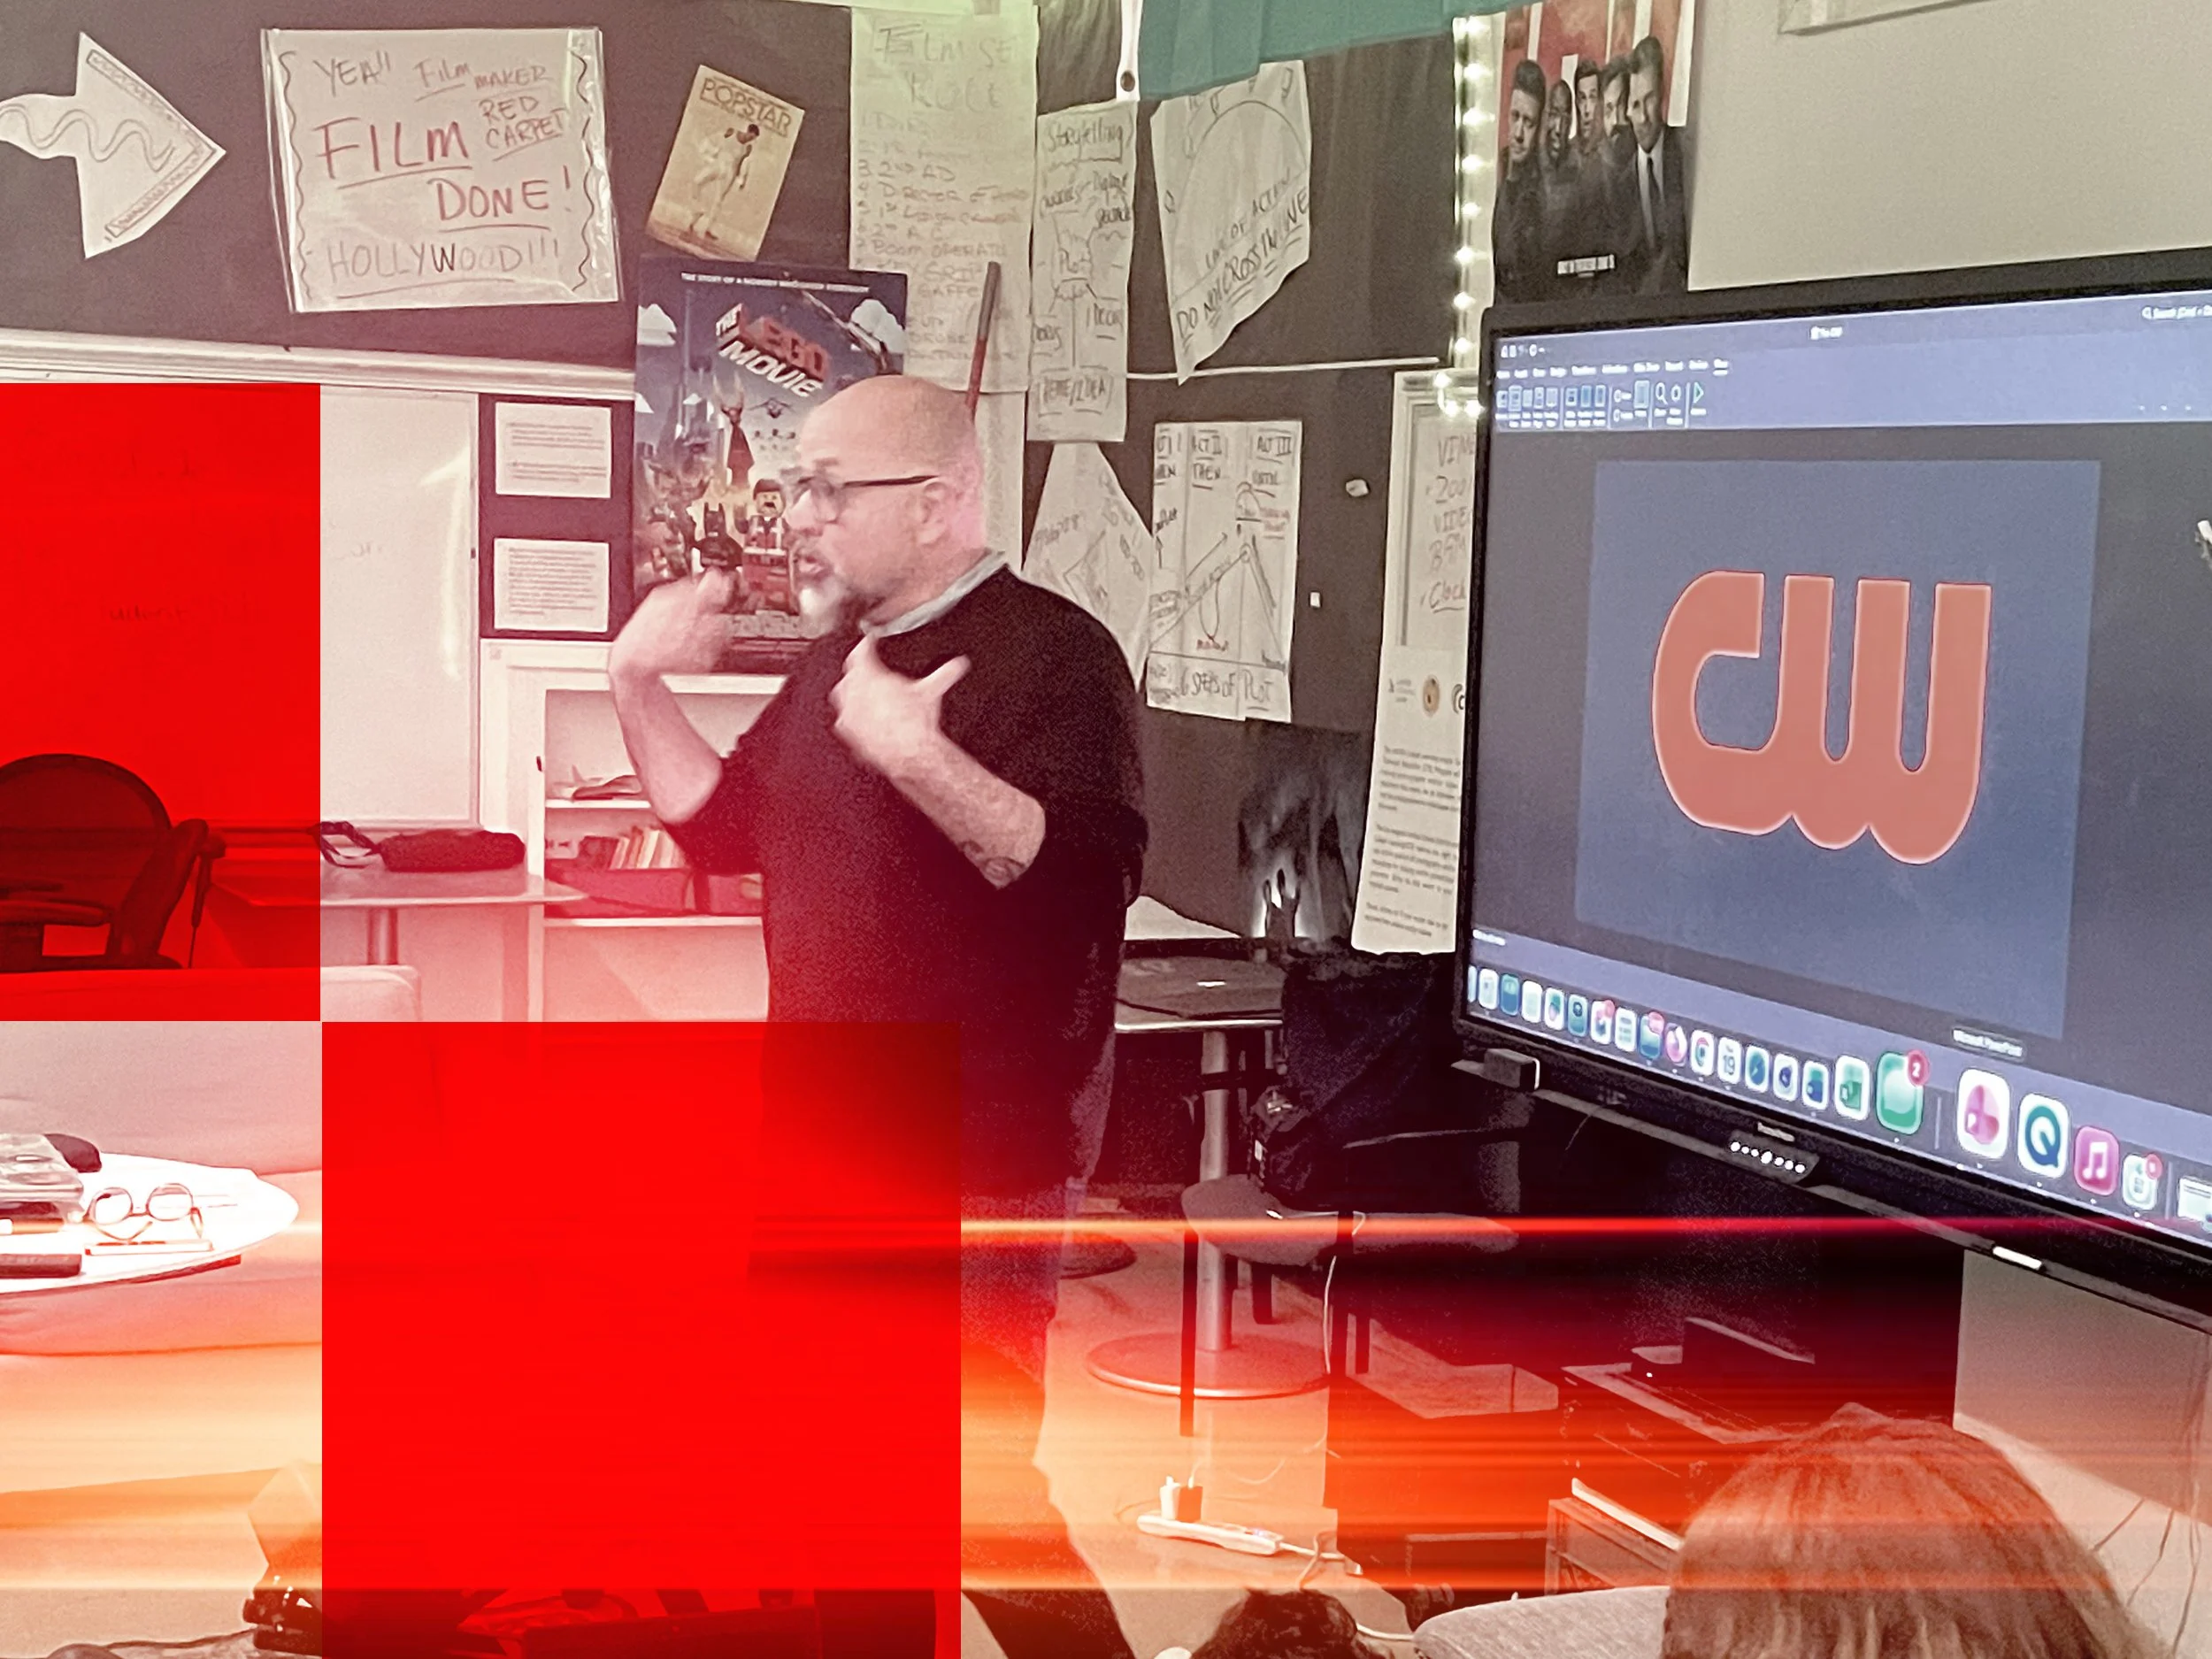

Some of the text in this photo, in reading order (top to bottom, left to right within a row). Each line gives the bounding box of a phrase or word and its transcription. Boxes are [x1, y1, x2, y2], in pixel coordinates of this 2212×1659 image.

[473, 65, 552, 89] MAKER
[478, 95, 540, 125] RED
[486, 106, 567, 149] CARPET
[699, 77, 792, 138] POPSTAR
[718, 340, 825, 398] MOVIE
